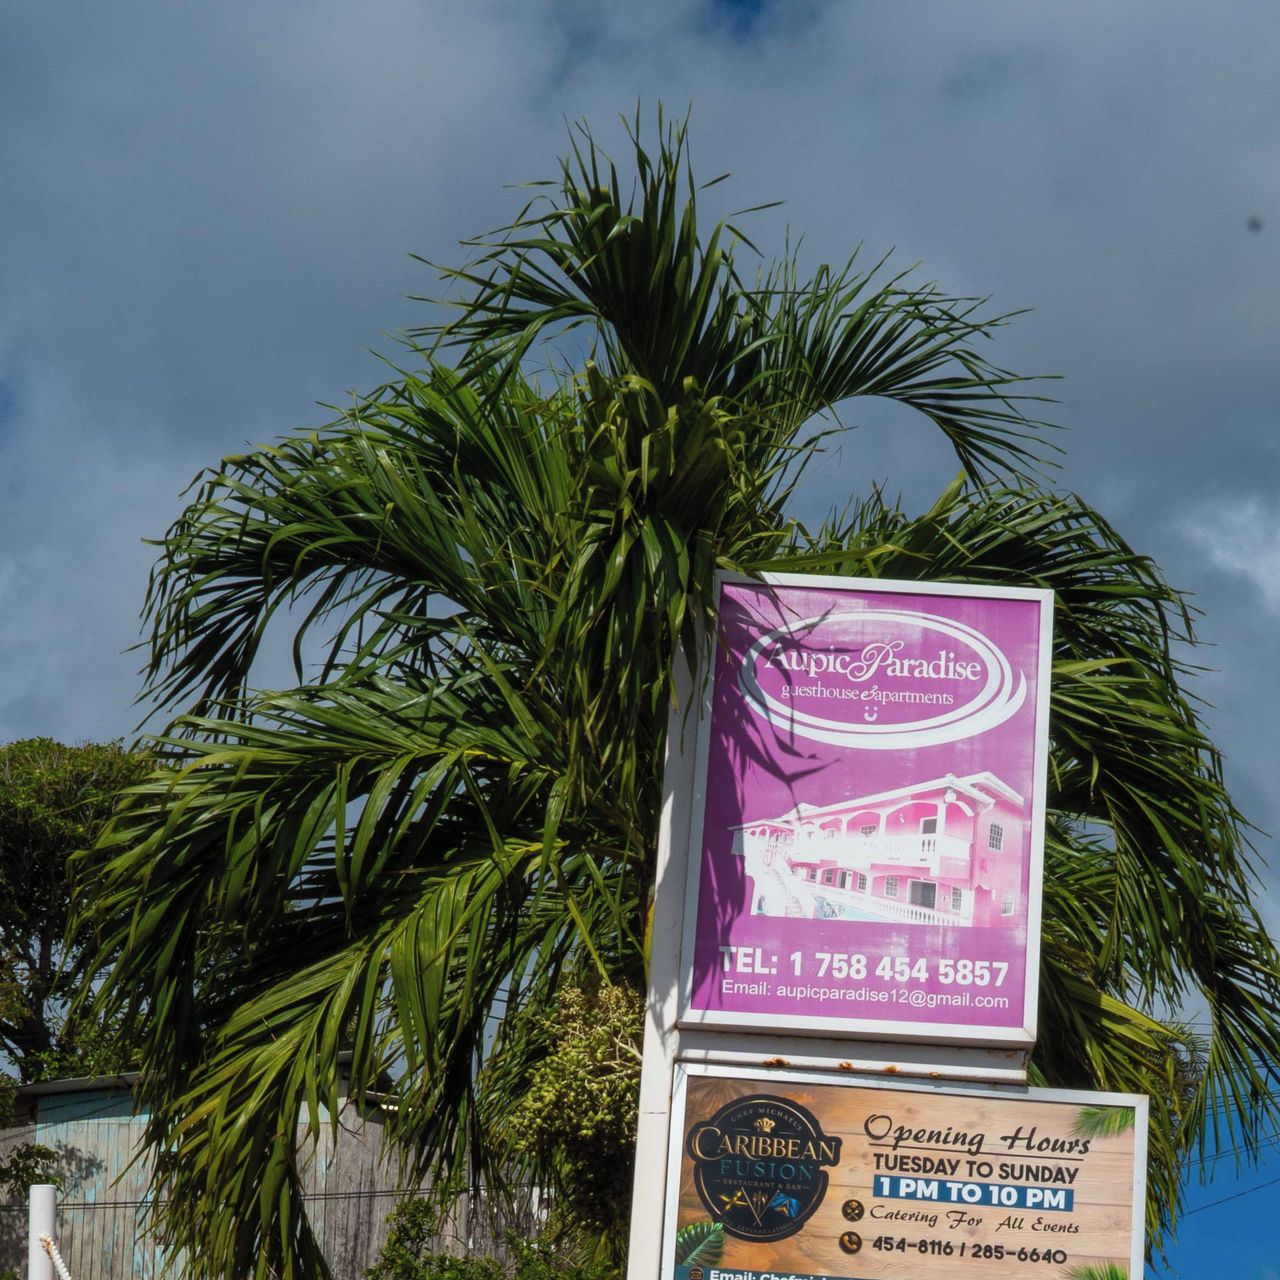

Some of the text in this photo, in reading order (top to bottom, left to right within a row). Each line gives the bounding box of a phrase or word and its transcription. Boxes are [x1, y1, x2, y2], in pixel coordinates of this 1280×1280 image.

[764, 641, 981, 681] Aupic Paradise
[781, 681, 859, 698] guesthouse
[874, 689, 954, 705] apartments
[720, 946, 1009, 987] TEL: 1 758 454 5857
[722, 979, 1009, 1008] Email: aupicparadise12@gmail.com
[692, 1126, 836, 1161] CARIBBEAN
[864, 1113, 1091, 1156] Opening Hours
[721, 1159, 813, 1181] FUSION
[873, 1153, 1080, 1185] TUESDAY TO SUNDAY
[880, 1177, 1065, 1209] 1 PM TO 10 PM
[870, 1204, 1080, 1234] Catering For All Events
[872, 1236, 954, 1256] 454-8116
[971, 1244, 1067, 1264] 285-6640
